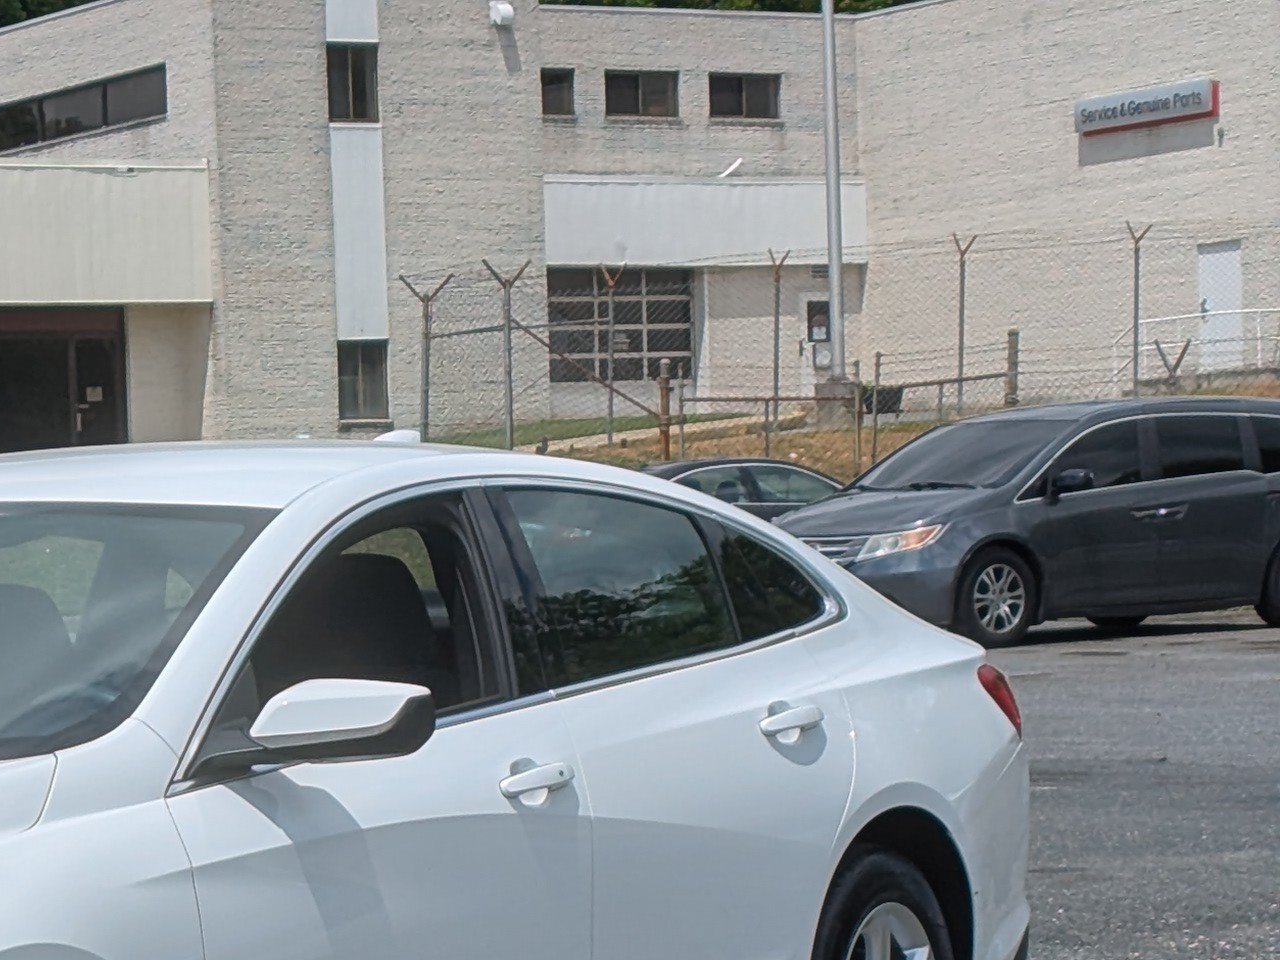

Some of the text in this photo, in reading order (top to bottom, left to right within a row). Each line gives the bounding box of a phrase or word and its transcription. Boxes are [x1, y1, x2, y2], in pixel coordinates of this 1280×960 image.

[1080, 91, 1202, 123] Service & Genuine Parts
